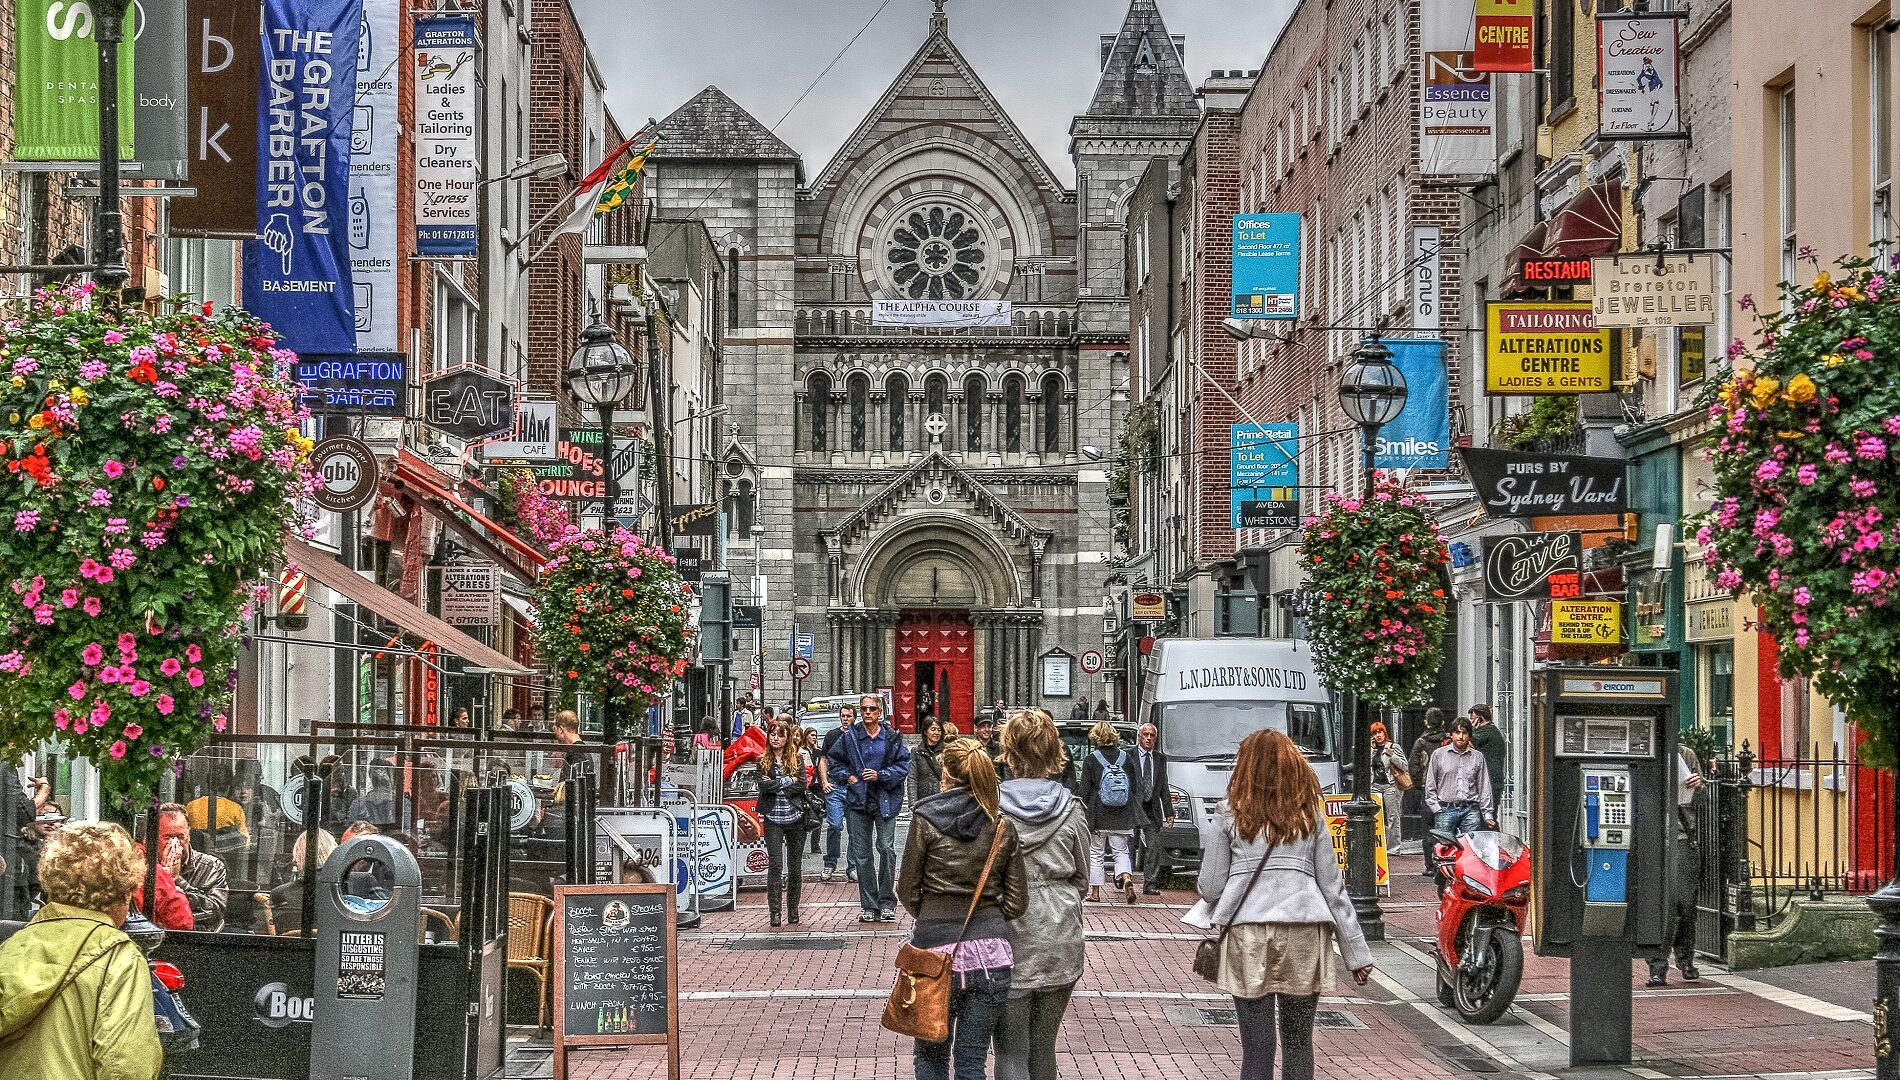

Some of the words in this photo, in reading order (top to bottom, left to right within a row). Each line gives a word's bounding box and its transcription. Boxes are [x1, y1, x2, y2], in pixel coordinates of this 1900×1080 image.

[1479, 26, 1529, 44] CENTRE
[1620, 20, 1657, 41] Sew
[274, 28, 333, 54] THE
[1608, 40, 1664, 57] Creative
[426, 84, 465, 94] Ladies
[1426, 87, 1490, 100] Essence
[140, 93, 177, 110] body
[441, 97, 451, 107] &
[428, 110, 464, 120] Gents
[1424, 106, 1488, 121] Beauty
[419, 123, 472, 136] Tailoring
[1621, 121, 1639, 129] Floor
[267, 59, 296, 208] BARBER
[301, 59, 333, 235] GRAFTON
[435, 145, 457, 157] Dry
[419, 157, 472, 168] Cleaners
[418, 179, 442, 190] One
[445, 179, 475, 190] Hour
[423, 192, 469, 206] Xpress
[423, 207, 470, 218] Services
[1238, 219, 1270, 230] Offices
[418, 231, 431, 239] Ph:
[432, 231, 442, 239] 01
[443, 231, 475, 239] 6717813
[1238, 231, 1248, 240] To
[1251, 231, 1266, 240] Let
[1525, 260, 1591, 279] RESTAUR
[1619, 262, 1688, 275] Loran
[263, 280, 336, 293] BASEMENT
[1610, 279, 1698, 293] Brereton
[879, 303, 900, 312] THE
[902, 302, 936, 312] ALPHA
[939, 303, 980, 312] COURSE
[1594, 294, 1713, 314] JEWELLER
[1507, 314, 1593, 330] TAILORING
[1654, 317, 1672, 325] 1912
[1499, 338, 1603, 354] ALTERATIONS
[318, 362, 402, 380] GRAFTON
[1521, 358, 1580, 373] CENTRE
[1499, 377, 1546, 387] LADIES
[1548, 377, 1556, 386] &
[1560, 377, 1602, 386] GENTS
[431, 385, 507, 427] EAT
[570, 430, 604, 444] WINE
[1237, 431, 1263, 439] Prime
[1265, 430, 1292, 439] Retail
[523, 444, 547, 455] CAFÉ
[1375, 437, 1439, 455] Smiles
[314, 443, 344, 463] gourmet
[346, 443, 368, 464] burger
[557, 441, 605, 477] HOES
[1237, 453, 1247, 461] To
[324, 462, 357, 484] gbk
[1507, 463, 1544, 474] FURS
[1550, 462, 1569, 473] BY
[539, 480, 606, 498] OUNGE
[1488, 477, 1565, 513] Sydney
[1569, 475, 1621, 503] Vard
[325, 494, 356, 503] kitchen
[1244, 517, 1297, 526] WHETSTONE
[1548, 573, 1579, 583] WINE
[446, 581, 490, 590] XPRESS
[1550, 585, 1580, 597] BAR
[1086, 656, 1097, 665] 50
[1283, 669, 1306, 691] LTD
[342, 934, 372, 945] LITTER
[374, 934, 384, 945] IS
[342, 944, 384, 954] DISGUSTING
[571, 1001, 597, 1010] LUNCH
